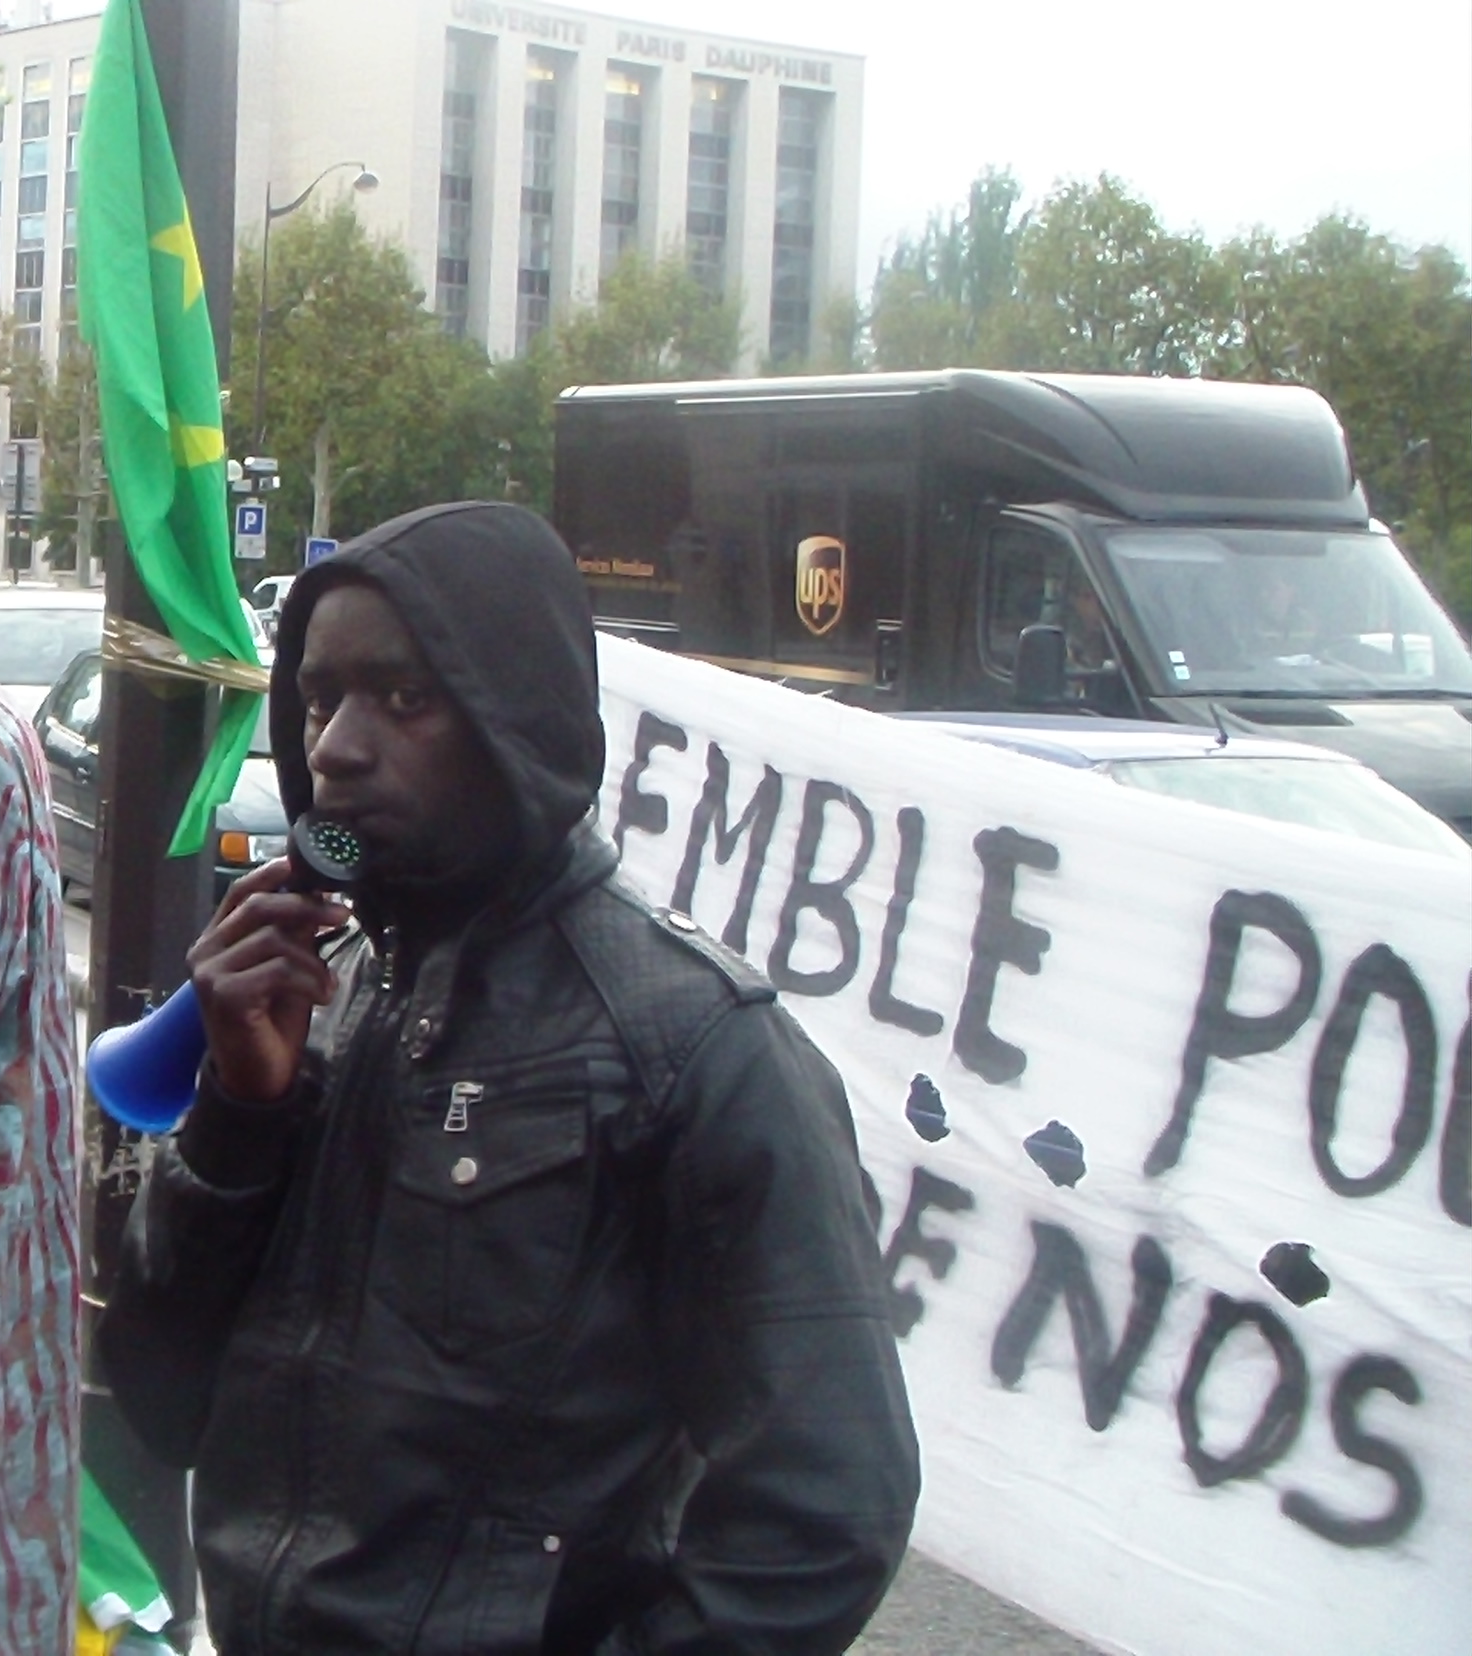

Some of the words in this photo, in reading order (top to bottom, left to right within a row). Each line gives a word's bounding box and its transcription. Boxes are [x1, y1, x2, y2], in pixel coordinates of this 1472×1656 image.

[617, 31, 686, 62] PARIS
[705, 45, 832, 84] DAUPHINE
[244, 511, 257, 530] P
[800, 567, 841, 619] ups
[991, 1222, 1422, 1547] NOS
